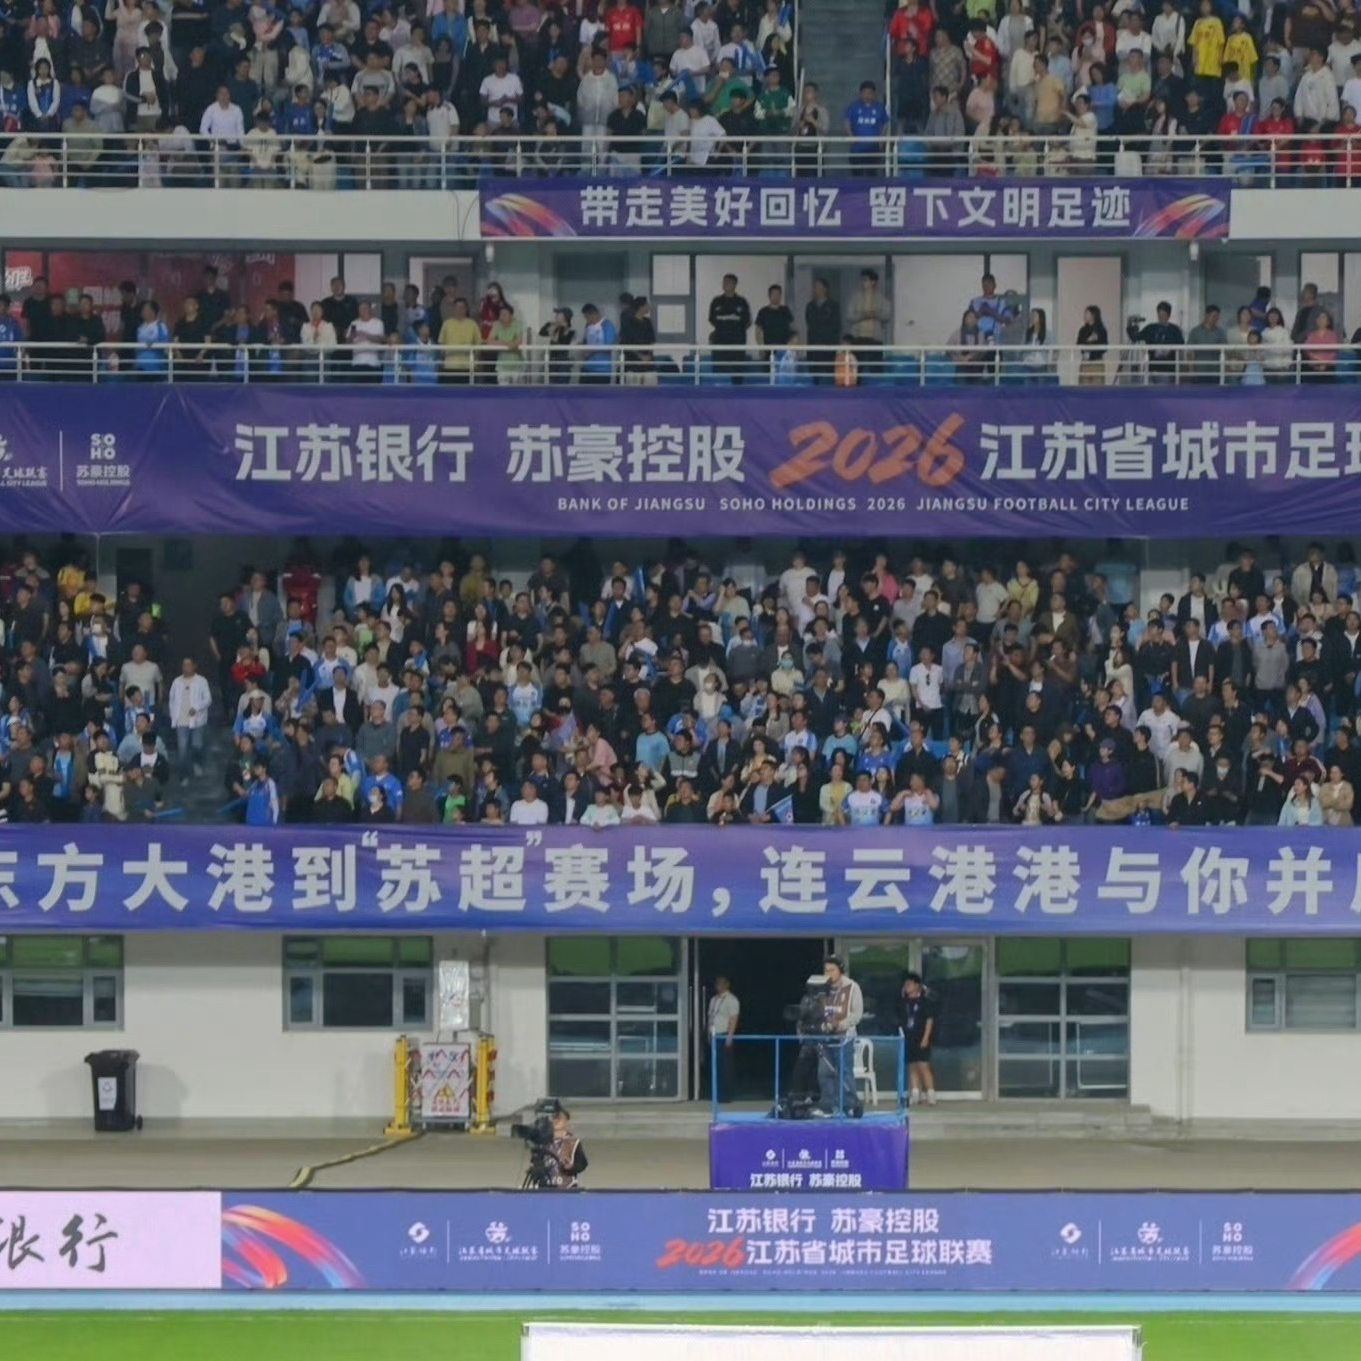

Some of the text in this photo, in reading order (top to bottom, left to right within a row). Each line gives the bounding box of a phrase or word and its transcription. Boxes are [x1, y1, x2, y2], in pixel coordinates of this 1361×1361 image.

[580, 186, 1132, 228] 带走美好回忆 留下文明足迹
[234, 423, 473, 482] 江苏银行
[505, 423, 746, 482] 苏豪控股
[767, 412, 966, 491] 2026
[76, 465, 131, 478] 苏豪控股
[557, 497, 1189, 511] BANK OF JIANGSU SOHO HOLDINGS 2026 JIANGSU FOOTBALL CITY LEAGUE
[750, 1172, 862, 1189] 江苏银行 苏豪控股
[707, 1207, 940, 1233] 江苏银行 苏豪控股
[655, 1236, 747, 1269] 2026
[746, 1239, 993, 1266] 江苏省城市足球联赛
